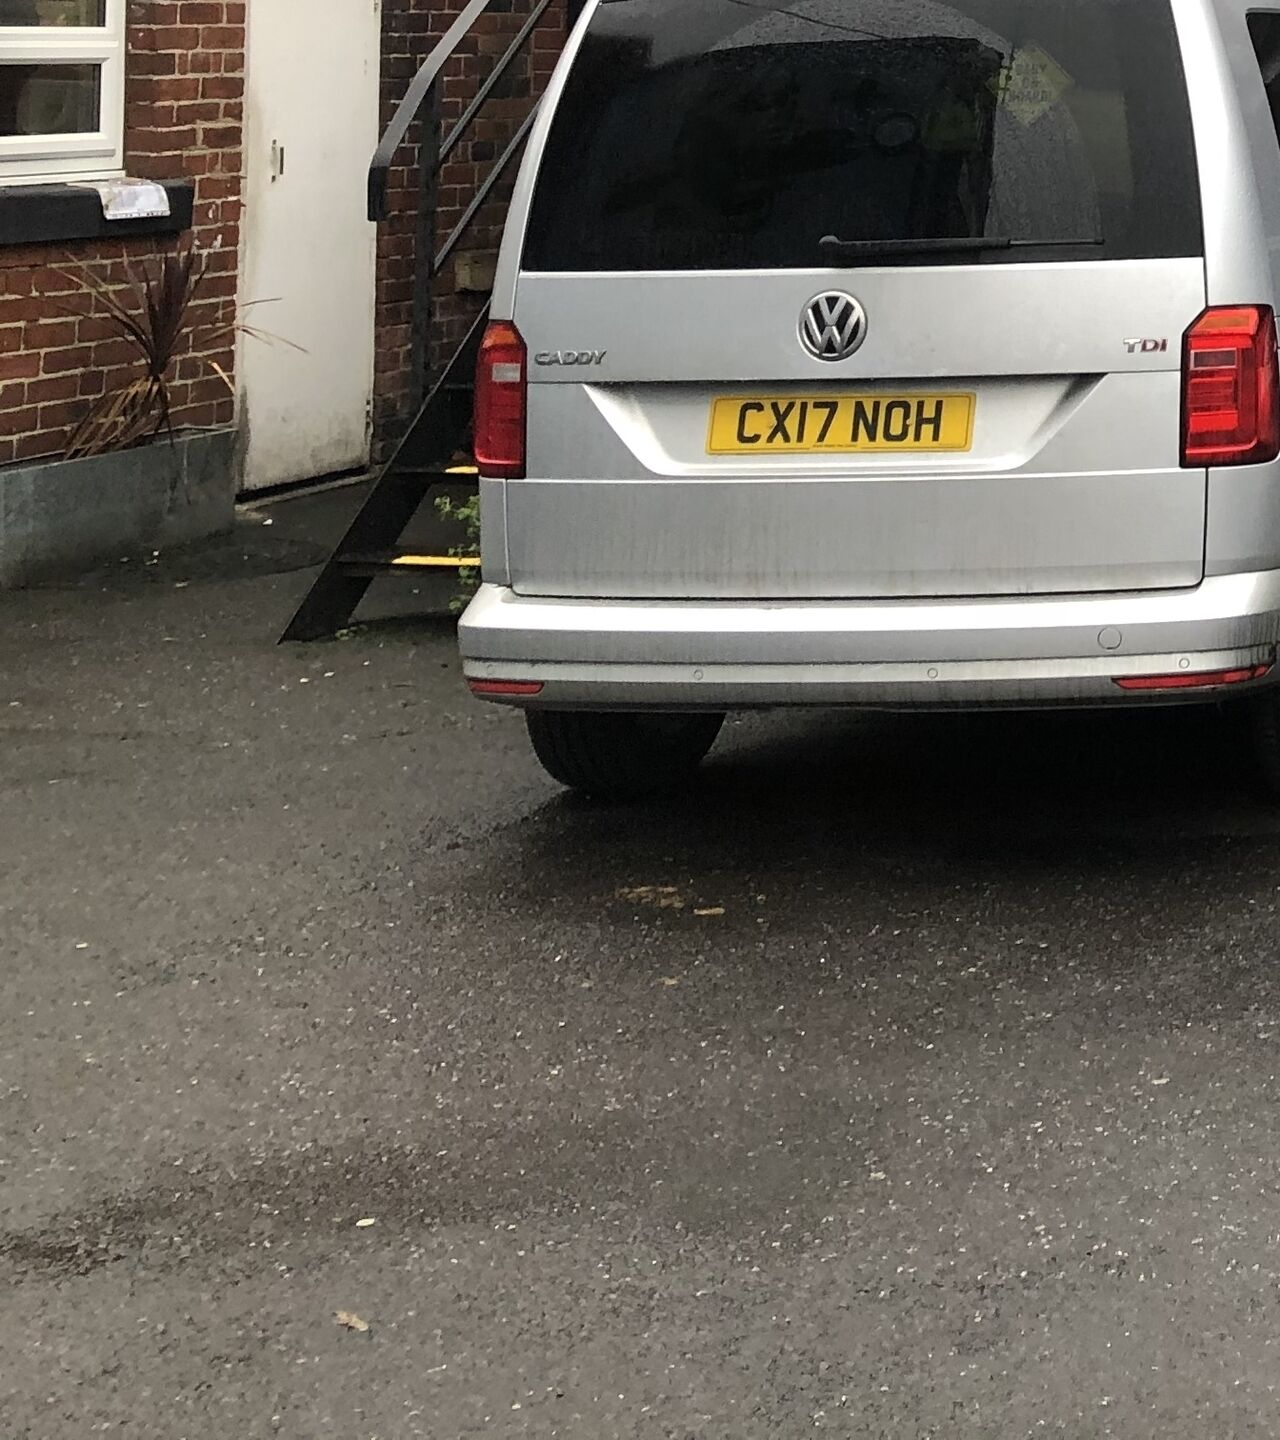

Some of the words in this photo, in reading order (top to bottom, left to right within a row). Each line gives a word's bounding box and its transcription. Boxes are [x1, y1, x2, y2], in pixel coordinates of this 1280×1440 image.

[1122, 338, 1168, 353] TDI
[534, 350, 607, 366] CADDY
[736, 400, 839, 444] CX17
[850, 399, 944, 443] NOH
